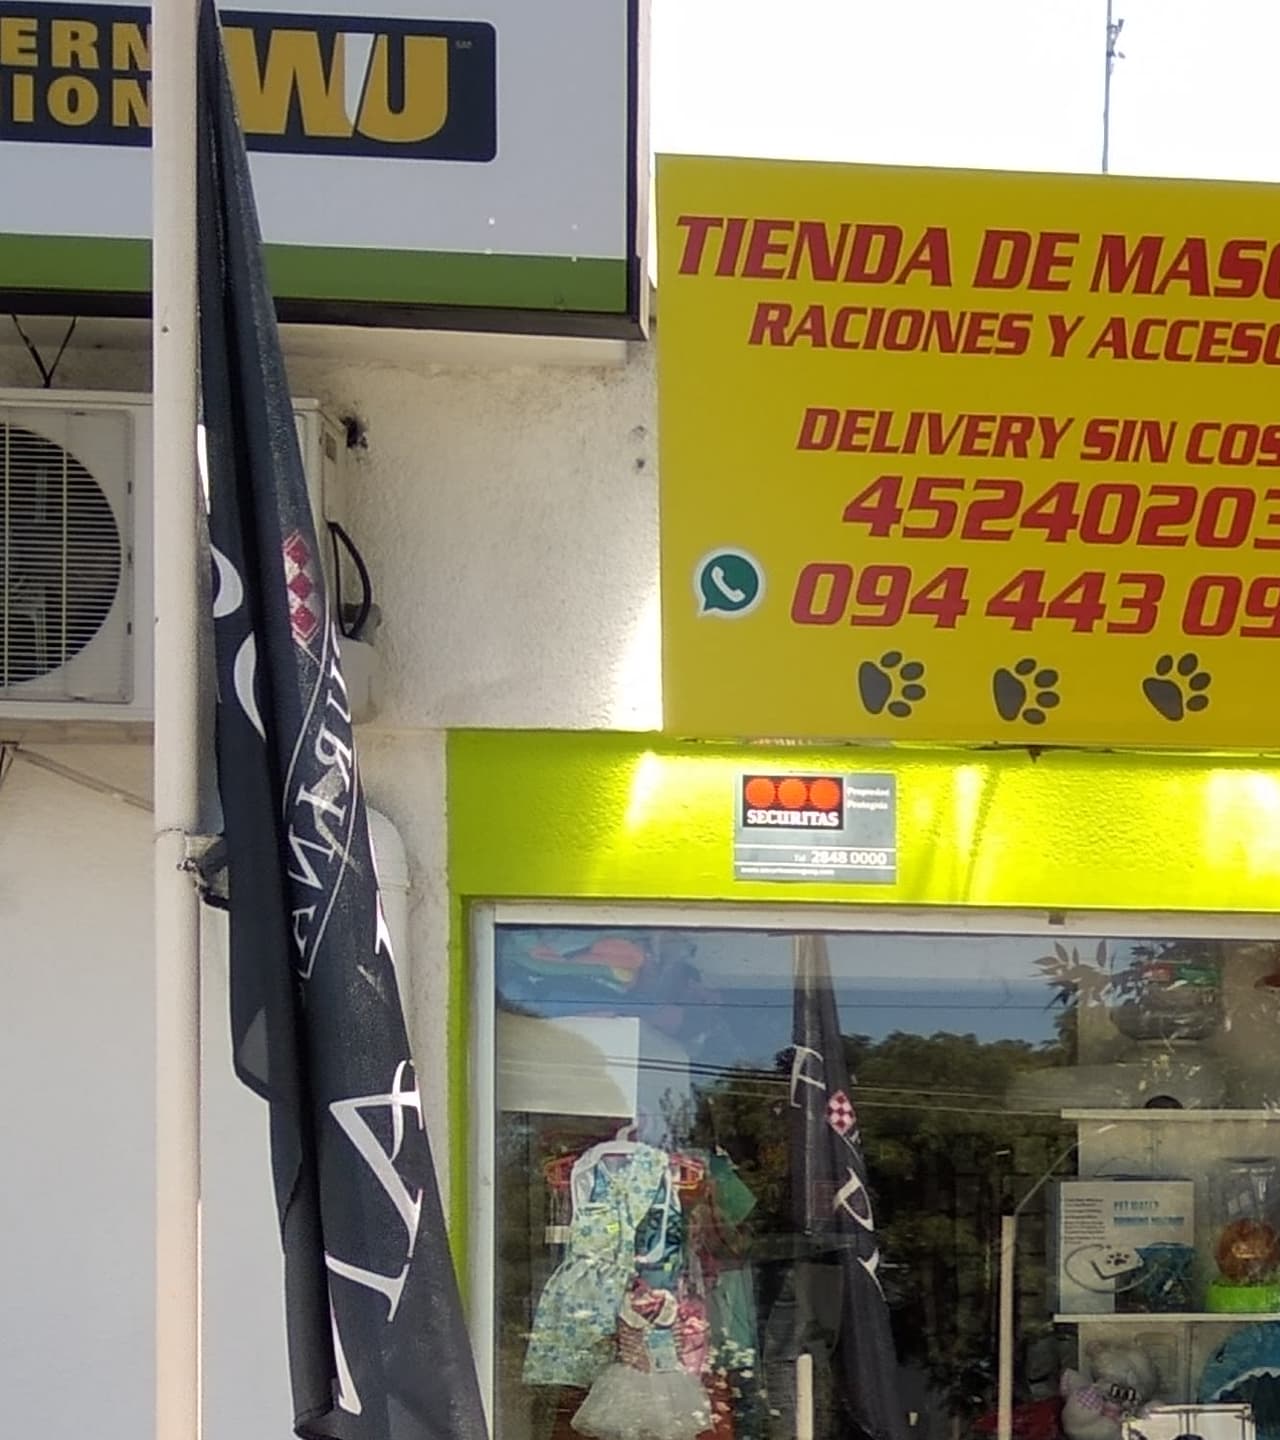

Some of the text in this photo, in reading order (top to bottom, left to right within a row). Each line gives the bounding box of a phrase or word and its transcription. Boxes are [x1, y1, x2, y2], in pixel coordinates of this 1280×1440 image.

[675, 215, 952, 288] TIENDA
[972, 229, 1080, 292] DE
[748, 302, 1033, 356] RACIONES
[1047, 315, 1084, 357] Y
[796, 407, 1074, 459] DELIVERY
[1080, 417, 1179, 464] SIN
[790, 562, 969, 629] 094
[984, 569, 1166, 635] 443
[747, 809, 839, 826] SECURITAS
